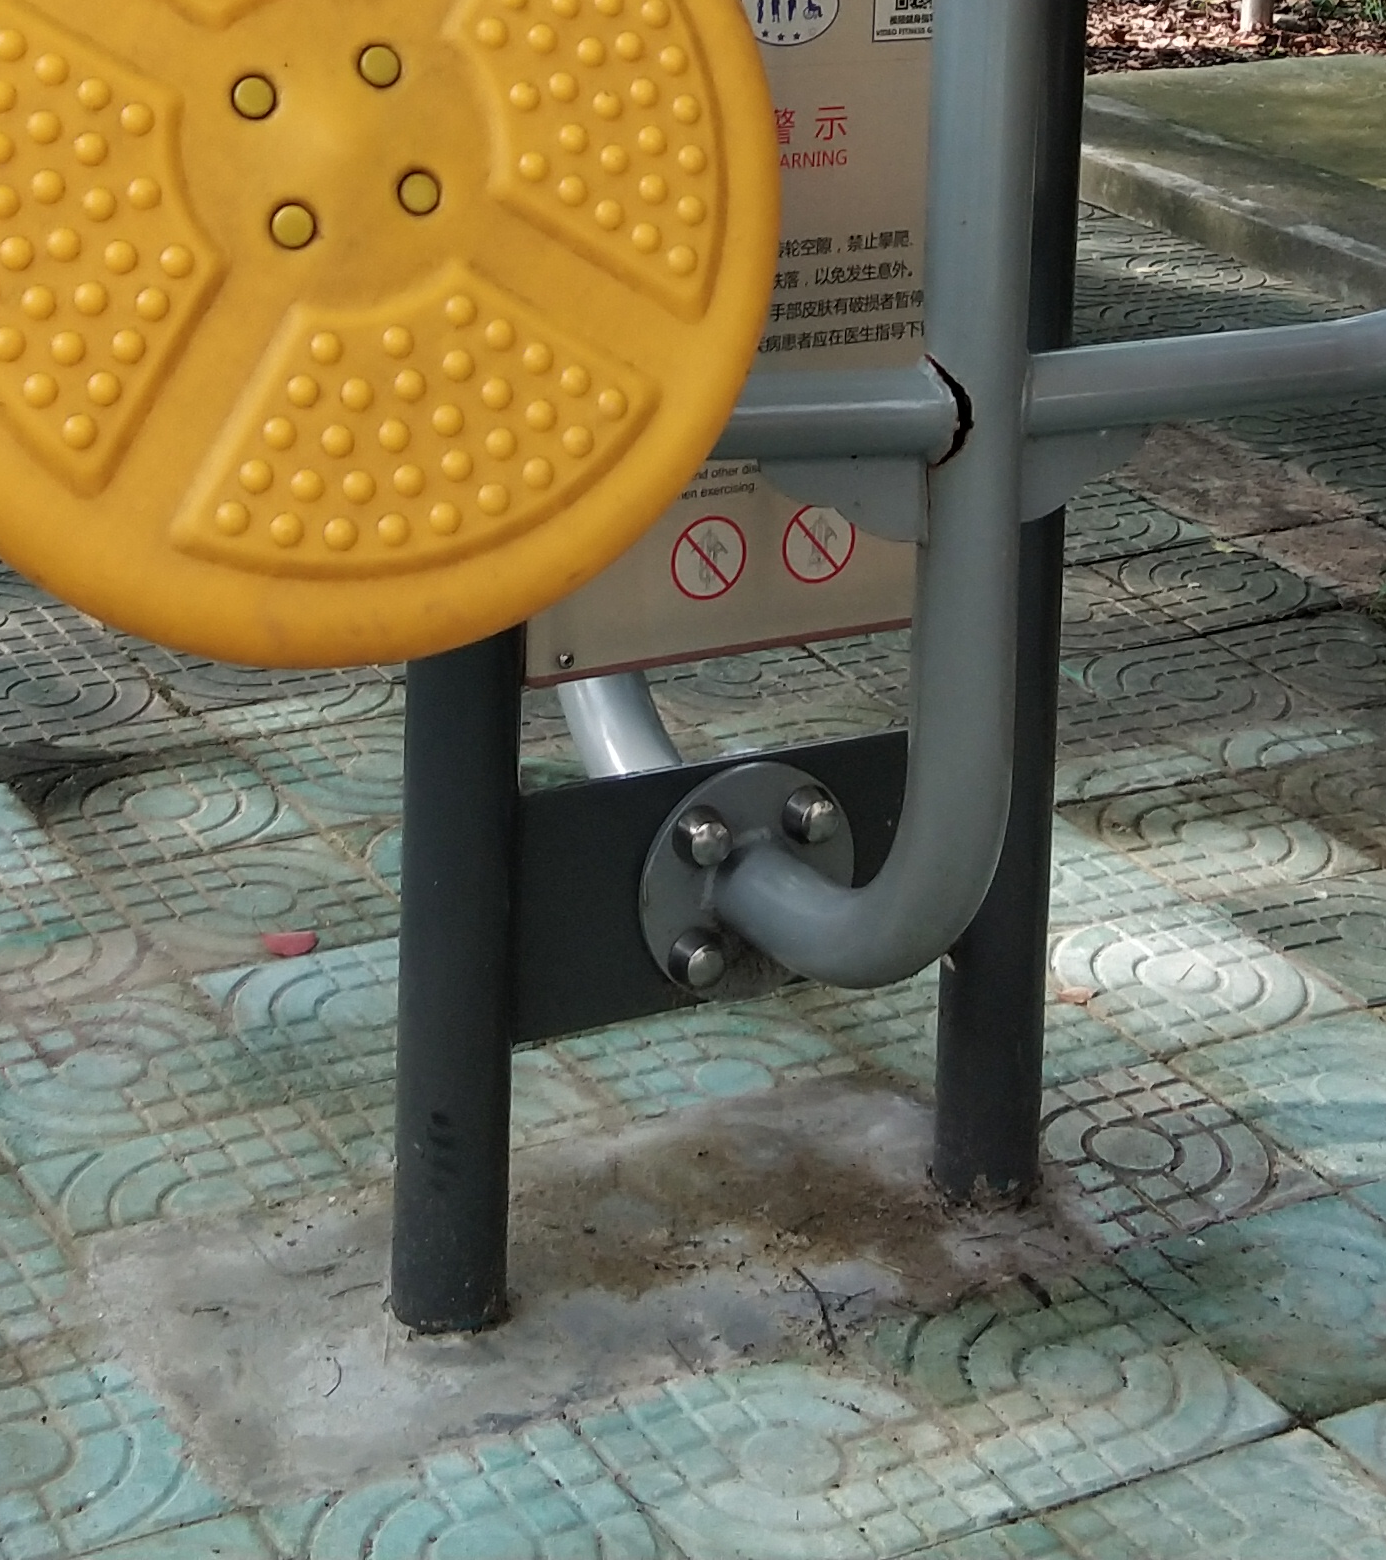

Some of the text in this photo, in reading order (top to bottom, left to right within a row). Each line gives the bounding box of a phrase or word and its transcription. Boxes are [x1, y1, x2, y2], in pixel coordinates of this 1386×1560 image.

[774, 105, 849, 145] 警示
[779, 149, 848, 168] ARNING
[757, 320, 925, 354] 病患者应在医生指导下
[711, 467, 739, 479] other
